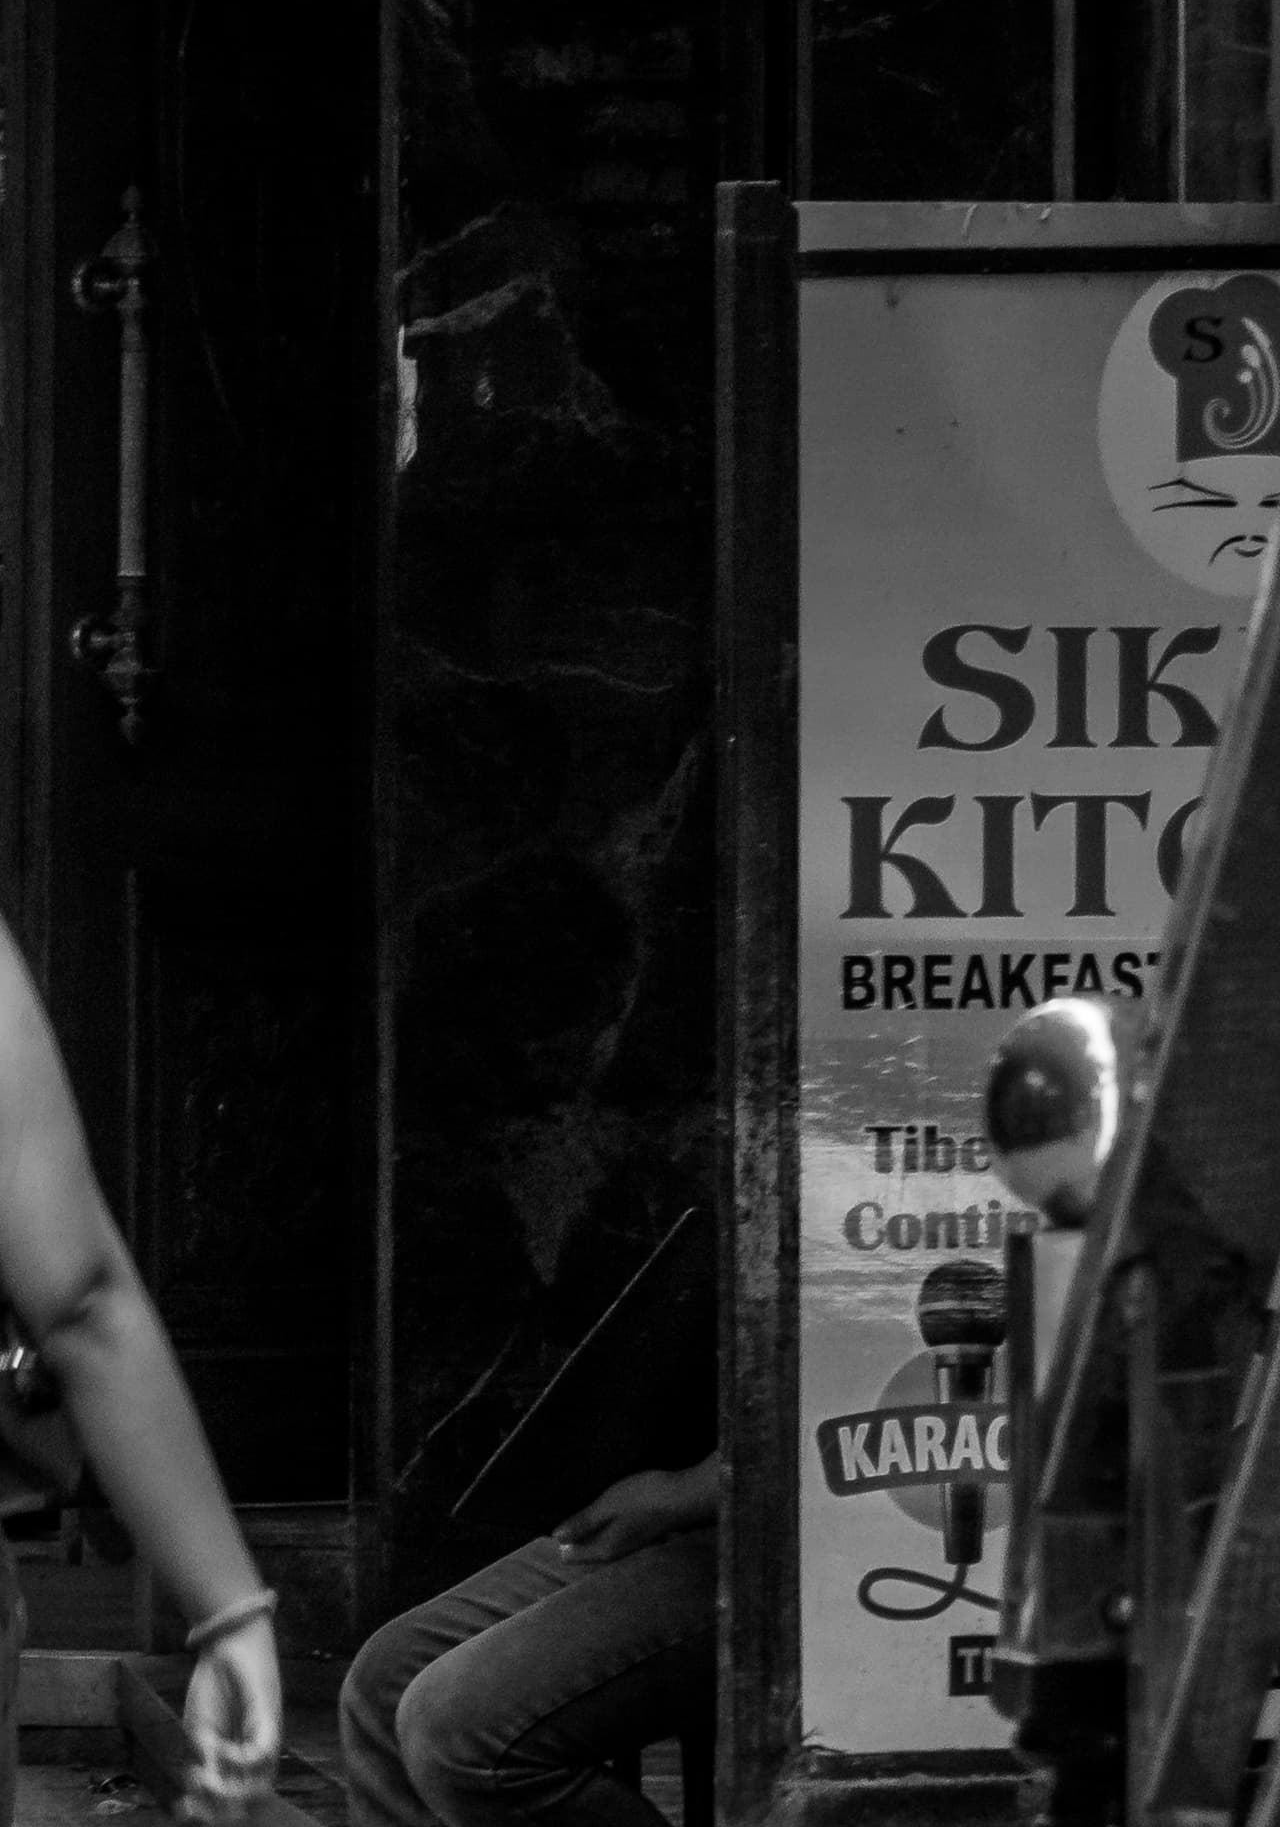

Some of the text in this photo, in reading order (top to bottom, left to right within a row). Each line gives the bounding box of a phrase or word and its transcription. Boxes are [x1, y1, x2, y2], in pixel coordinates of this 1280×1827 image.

[1184, 314, 1224, 363] S
[918, 624, 1246, 751] SIK
[843, 952, 1161, 1010] BREAKFAS
